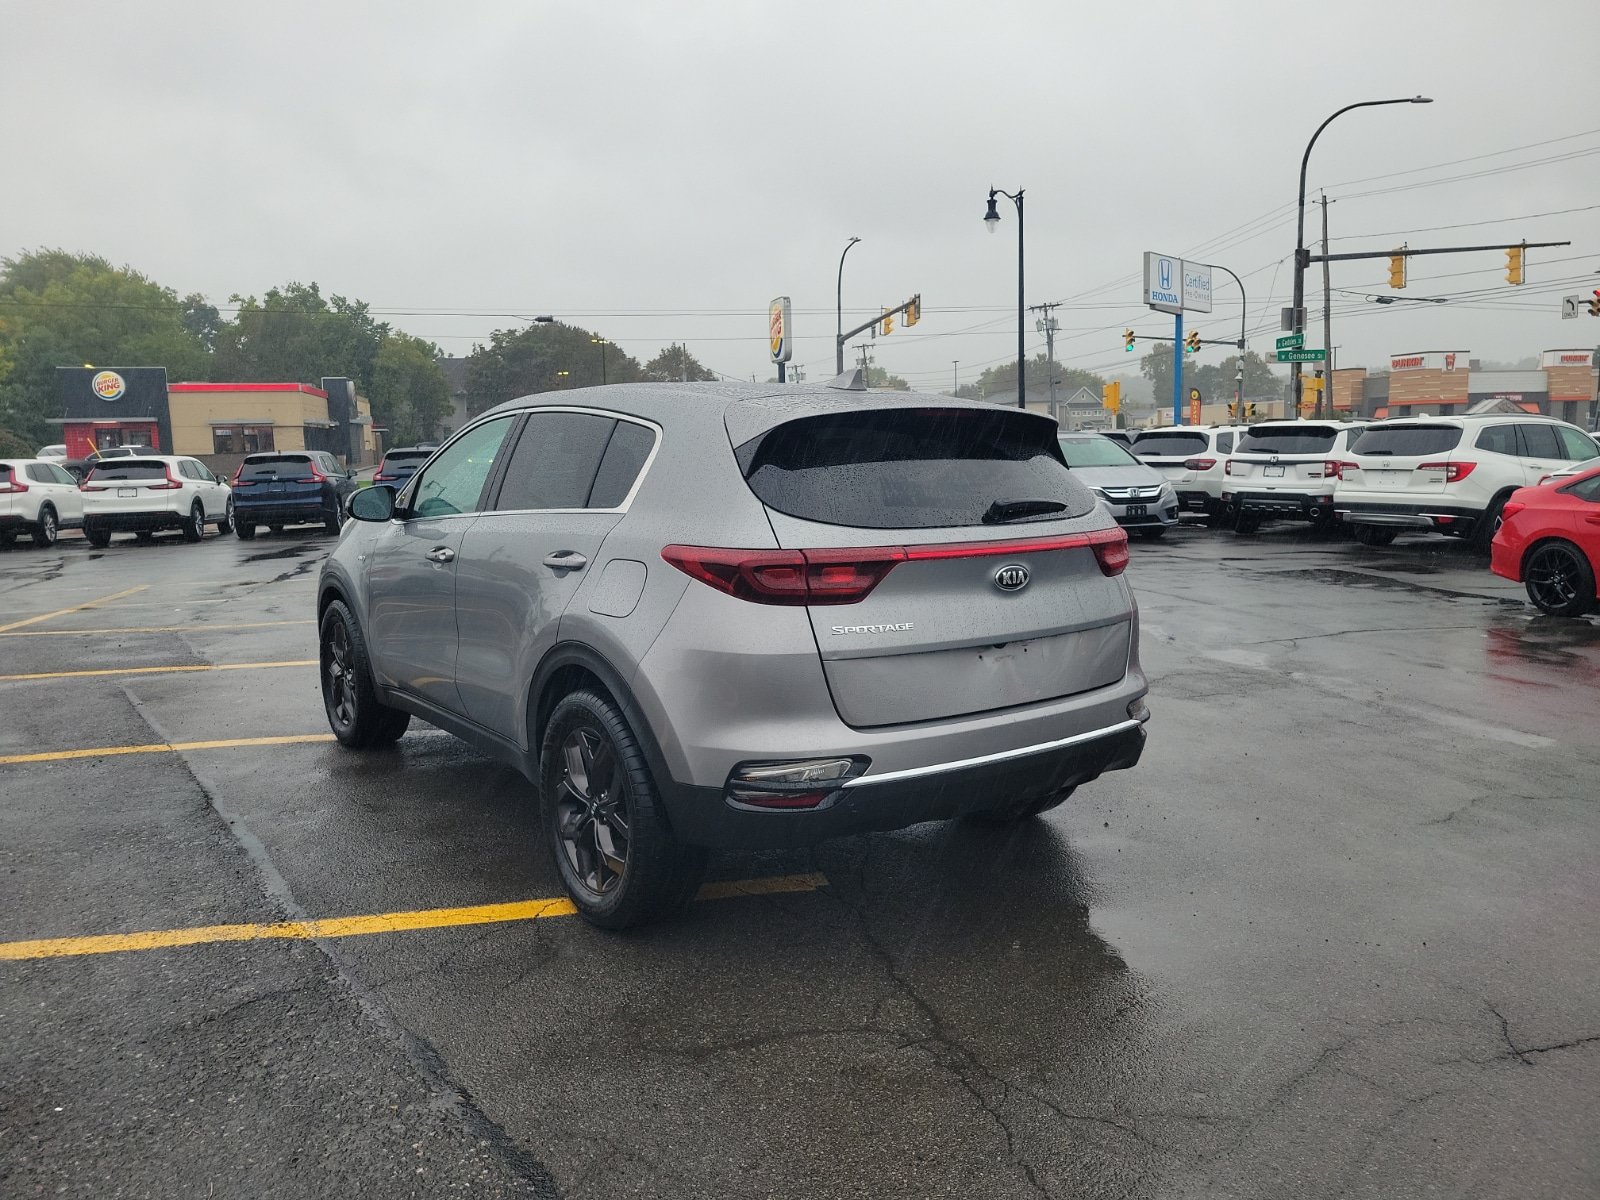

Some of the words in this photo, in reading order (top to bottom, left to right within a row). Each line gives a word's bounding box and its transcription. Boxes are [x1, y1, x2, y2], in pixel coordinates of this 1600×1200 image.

[1185, 273, 1210, 291] Certified
[1152, 291, 1178, 303] HONDA
[96, 377, 119, 387] BURGER
[98, 383, 120, 392] KING
[1002, 570, 1025, 585] KIA
[831, 622, 914, 635] SPORTAGE
